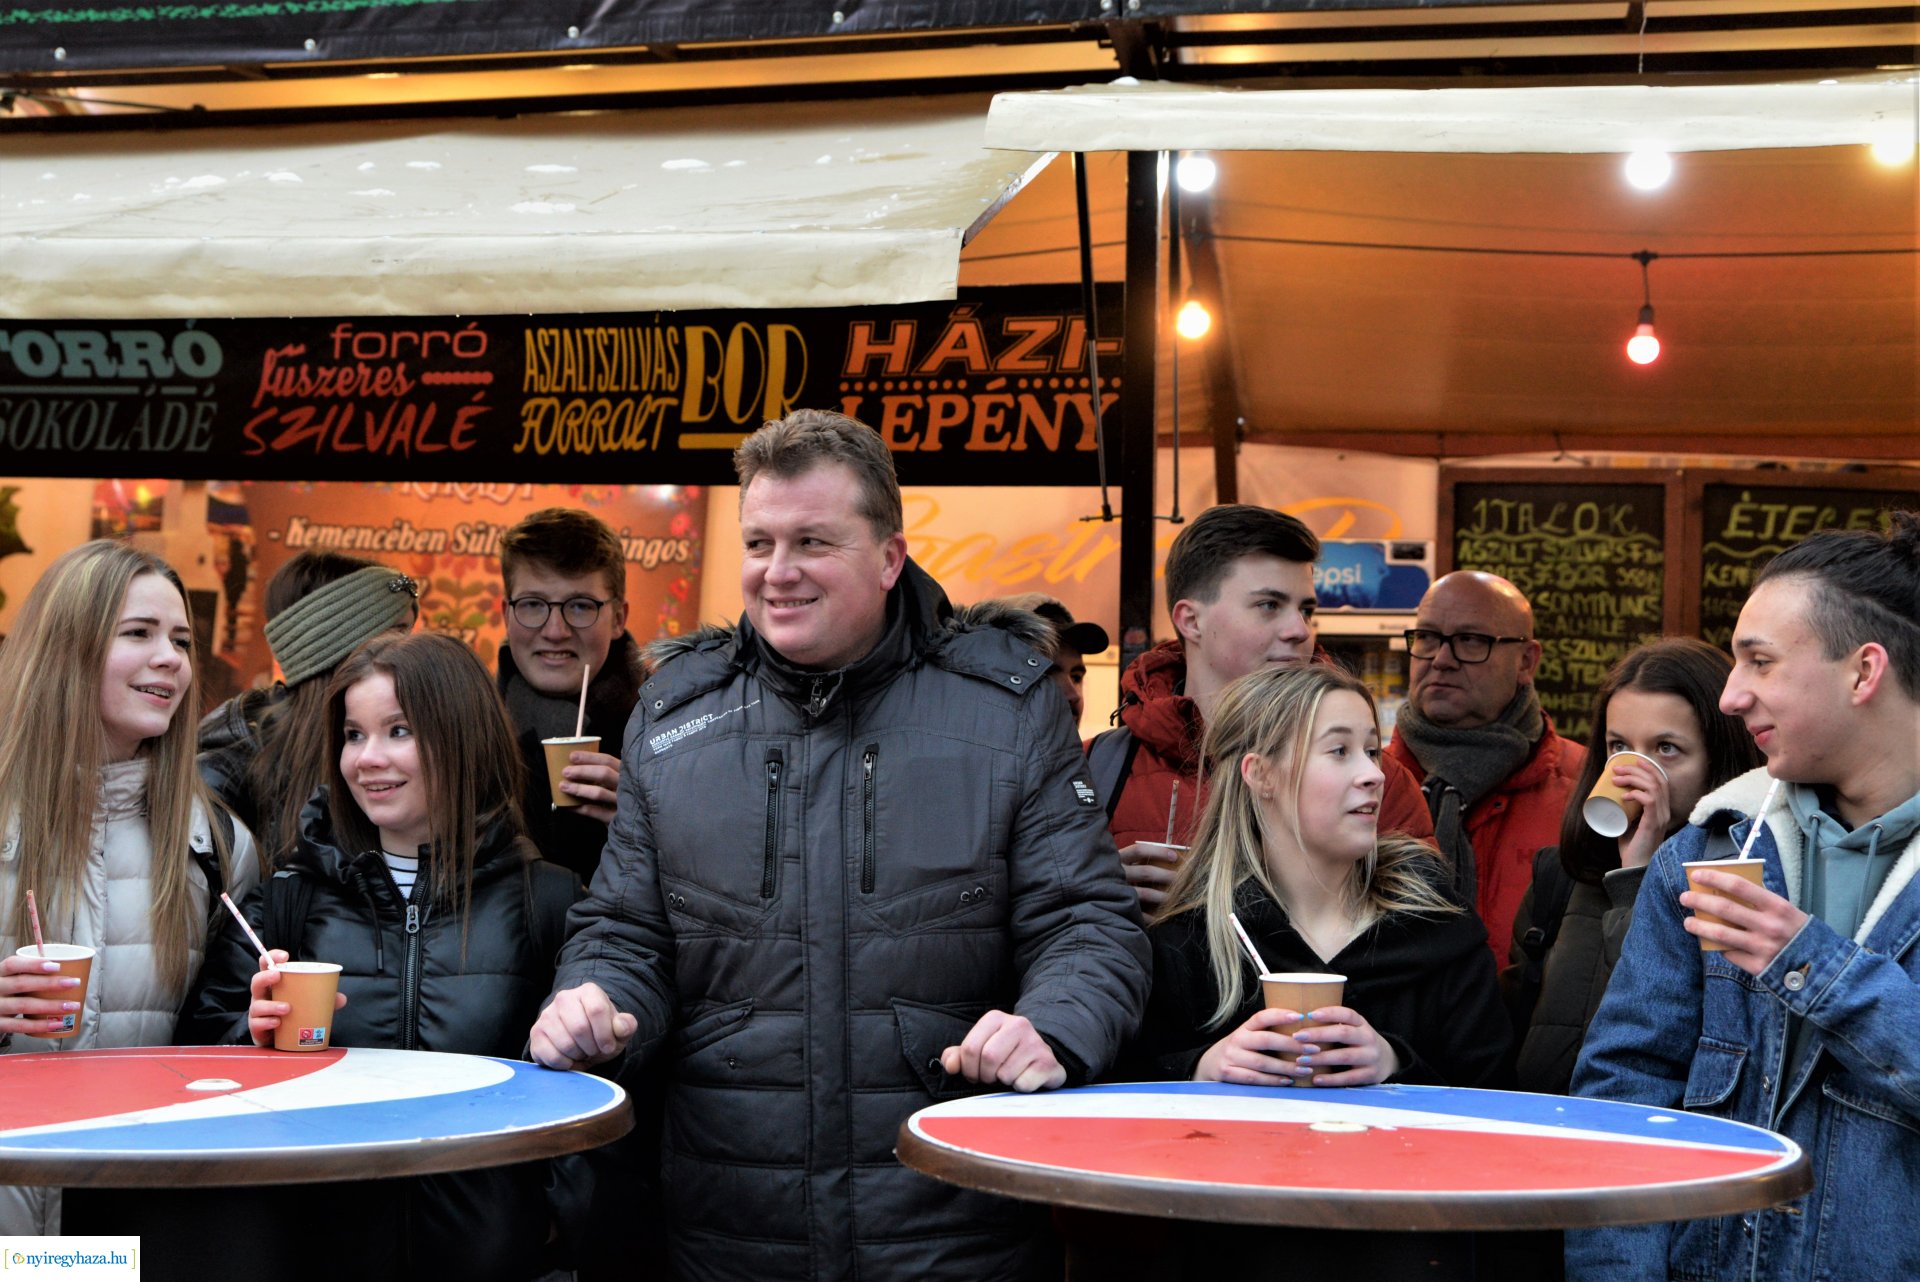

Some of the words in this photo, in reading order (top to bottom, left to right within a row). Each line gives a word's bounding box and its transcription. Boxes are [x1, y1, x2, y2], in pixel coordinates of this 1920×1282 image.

[0, 319, 223, 378] ORRÓ
[330, 322, 488, 360] forró
[523, 313, 680, 393] ASZALTSZILVÁS
[680, 321, 808, 425] BOR
[241, 390, 493, 459] SZILVALÉ
[841, 379, 1119, 452] EPÉNY
[1312, 563, 1362, 590] epsi
[649, 728, 678, 745] URBAN
[678, 713, 714, 732] DISTRICT
